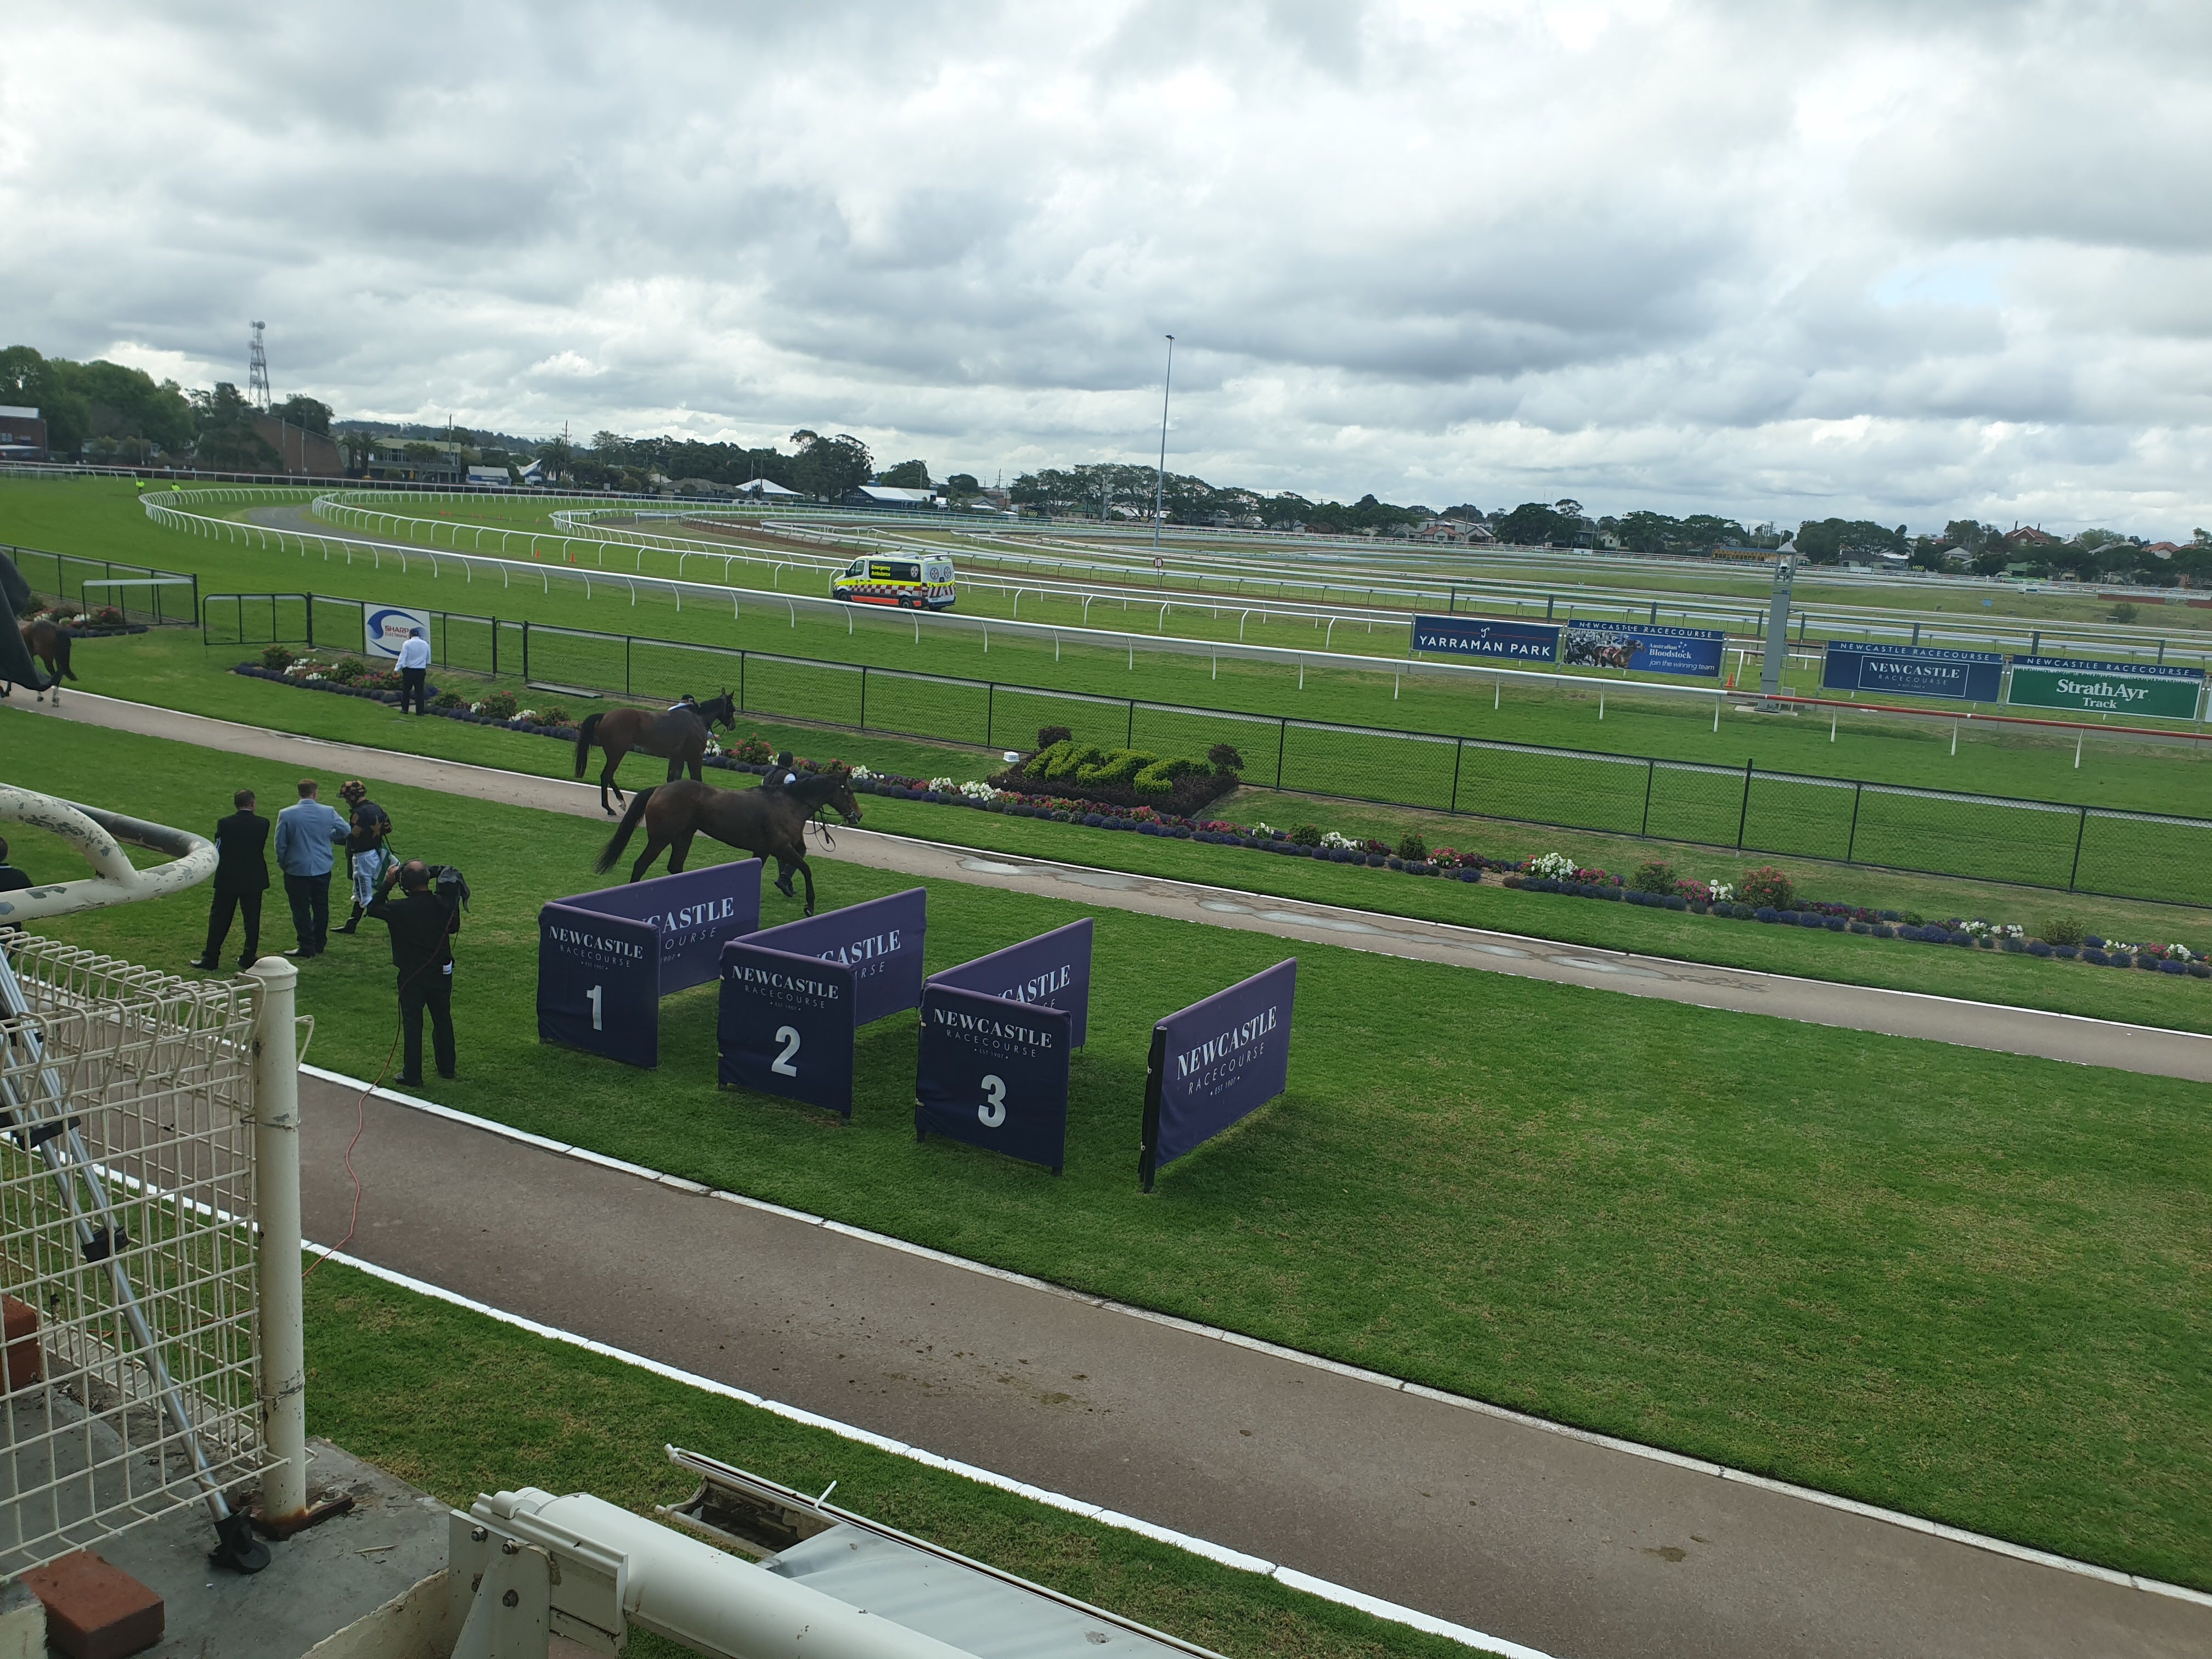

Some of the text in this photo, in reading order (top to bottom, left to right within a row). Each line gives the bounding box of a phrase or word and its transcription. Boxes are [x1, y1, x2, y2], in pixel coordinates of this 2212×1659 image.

[385, 625, 409, 634] SHARP
[1579, 622, 1712, 639] NEWCASTLE RACECOURSE
[1419, 635, 1550, 657] YARRAMAN PARK
[1649, 648, 1692, 659] Bloodstock
[1841, 643, 1990, 661] NEWCASTLE RACECOURSE
[1673, 661, 1697, 670] winning
[1869, 662, 1960, 679] NEWCASTLE
[2027, 658, 2190, 676] NEWCASTLE RACECOURSE
[1878, 674, 1948, 685] RACECOURSE
[2056, 679, 2149, 701] StrathAyr
[2083, 697, 2118, 709] Track
[549, 926, 643, 959] NEWCASTLE
[560, 944, 631, 967] RACECOURSE
[732, 966, 839, 999] NEWCASTLE
[745, 984, 825, 1008] RACECOURSE
[586, 985, 602, 1031] 1
[933, 1008, 1052, 1048] NEWCASTLE
[771, 1025, 800, 1077] 2
[947, 1029, 1036, 1057] RACECOURSE
[1177, 1006, 1277, 1080] NEWCASTLE
[1188, 1042, 1265, 1095] RACECOURSE
[1215, 1077, 1236, 1095] EST 1907
[978, 1074, 1006, 1127] 3
